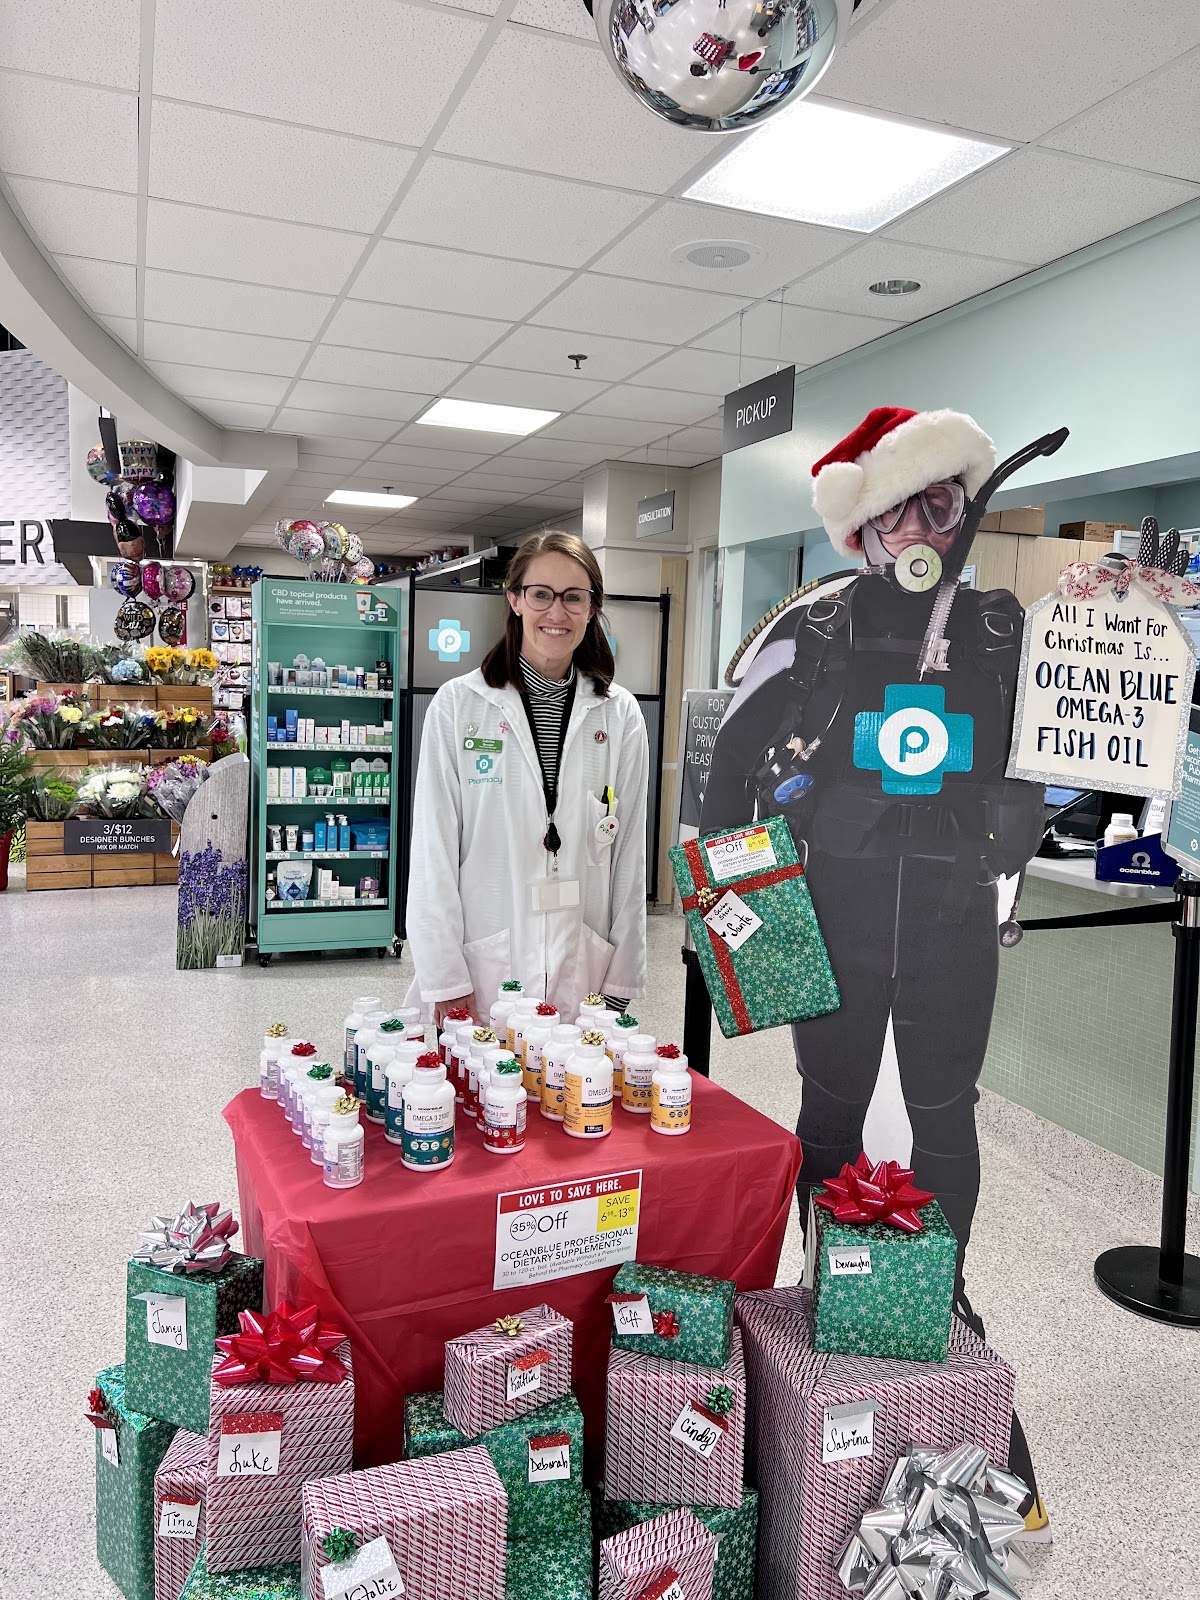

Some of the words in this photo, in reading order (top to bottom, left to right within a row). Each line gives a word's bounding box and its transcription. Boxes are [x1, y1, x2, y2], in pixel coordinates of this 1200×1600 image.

[736, 396, 777, 429] PICKUP
[121, 447, 153, 455] HAPPY
[123, 468, 154, 476] HAPPY
[638, 506, 672, 524] CONSULTATION
[271, 588, 289, 597] CBD
[290, 590, 315, 599] topical
[315, 592, 348, 600] products
[276, 596, 293, 605] have
[294, 599, 322, 607] arrived.
[124, 614, 143, 622] WILD
[1051, 603, 1077, 623] All
[1086, 608, 1095, 627] I
[1105, 612, 1141, 634] Want
[1146, 618, 1168, 637] For
[1044, 630, 1125, 655] Christmas
[1134, 642, 1169, 661] Is...
[1035, 661, 1110, 695] OCEAN
[1120, 670, 1179, 704] BLUE
[707, 698, 725, 712] FOR
[1056, 695, 1145, 728] OMEGA-3
[692, 716, 723, 730] CUSTO
[1037, 726, 1096, 760] FISH
[1107, 735, 1149, 768] OIL
[468, 777, 503, 785] Pharmacy
[103, 824, 133, 835] 3/$12
[79, 836, 118, 844] DESIGNER
[119, 835, 156, 843] BUNCHES
[725, 840, 743, 853] Off
[1119, 867, 1161, 876] oceanblue
[718, 906, 733, 920] Steve
[726, 913, 753, 937] Santa
[519, 1192, 545, 1208] LOVE
[550, 1189, 563, 1201] TO
[568, 1183, 592, 1199] SAVE
[596, 1179, 622, 1193] HERE.
[606, 1195, 631, 1208] SAVE
[511, 1220, 536, 1233] 35%
[537, 1211, 569, 1233] Off
[500, 1242, 562, 1262] OCEANBLUE
[564, 1227, 634, 1248] PROFESSIONAL
[513, 1254, 554, 1269] DIETARY
[555, 1238, 622, 1260] SUPPLEMENTS
[550, 1257, 576, 1269] (Available
[576, 1253, 597, 1262] Without
[601, 1245, 632, 1256] Prescription
[528, 1270, 548, 1279] Behind
[558, 1262, 583, 1273] Pharmacy
[152, 1308, 183, 1346] Janey
[680, 1417, 717, 1452] Cindy
[826, 1427, 872, 1453] Sabrina
[530, 1450, 568, 1473] Deborah
[163, 1511, 196, 1528] Tina
